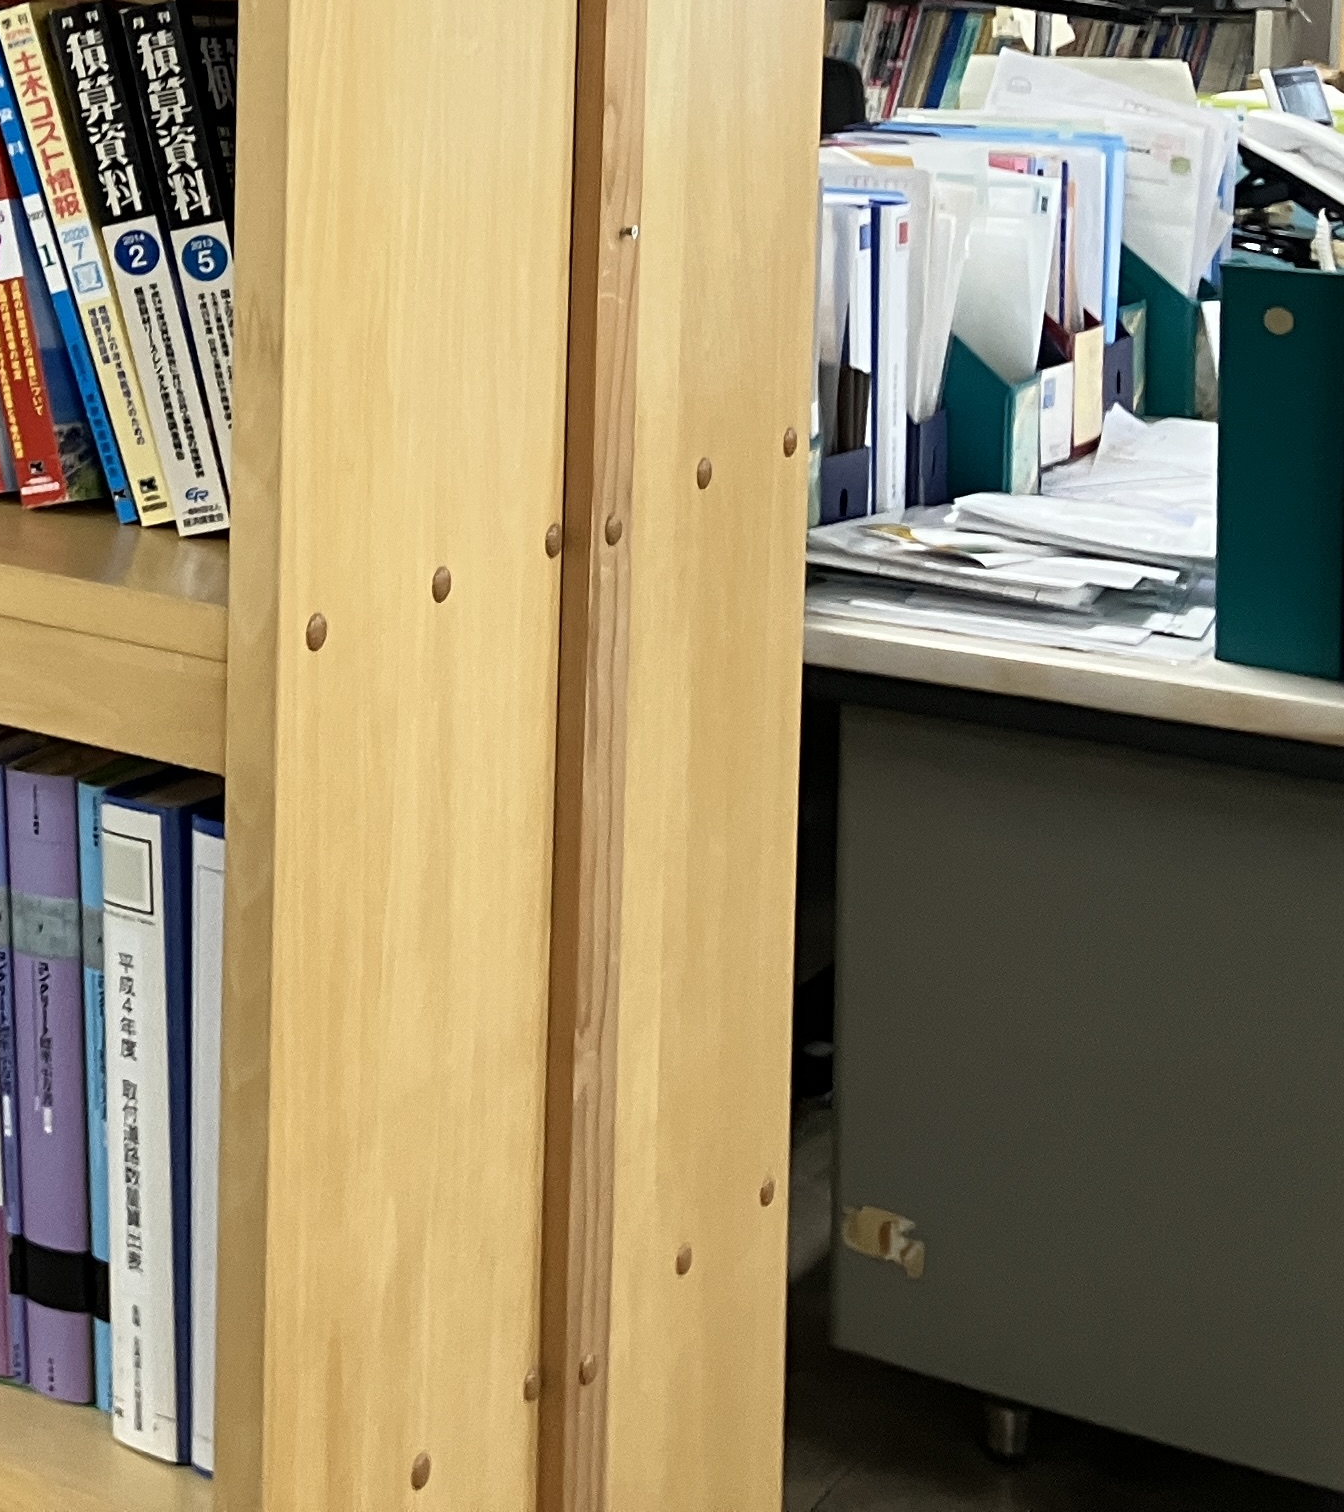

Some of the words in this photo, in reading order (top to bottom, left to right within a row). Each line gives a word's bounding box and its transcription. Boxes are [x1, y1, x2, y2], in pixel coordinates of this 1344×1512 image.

[61, 10, 99, 30] 月刊
[132, 10, 171, 30] 月刊
[13, 50, 83, 219] 土木コスト情報
[66, 28, 144, 218] 積算資料
[136, 31, 212, 222] 積算資料
[38, 243, 55, 268] 1
[72, 242, 85, 261] 7
[129, 244, 148, 270] 2
[196, 249, 215, 274] 5
